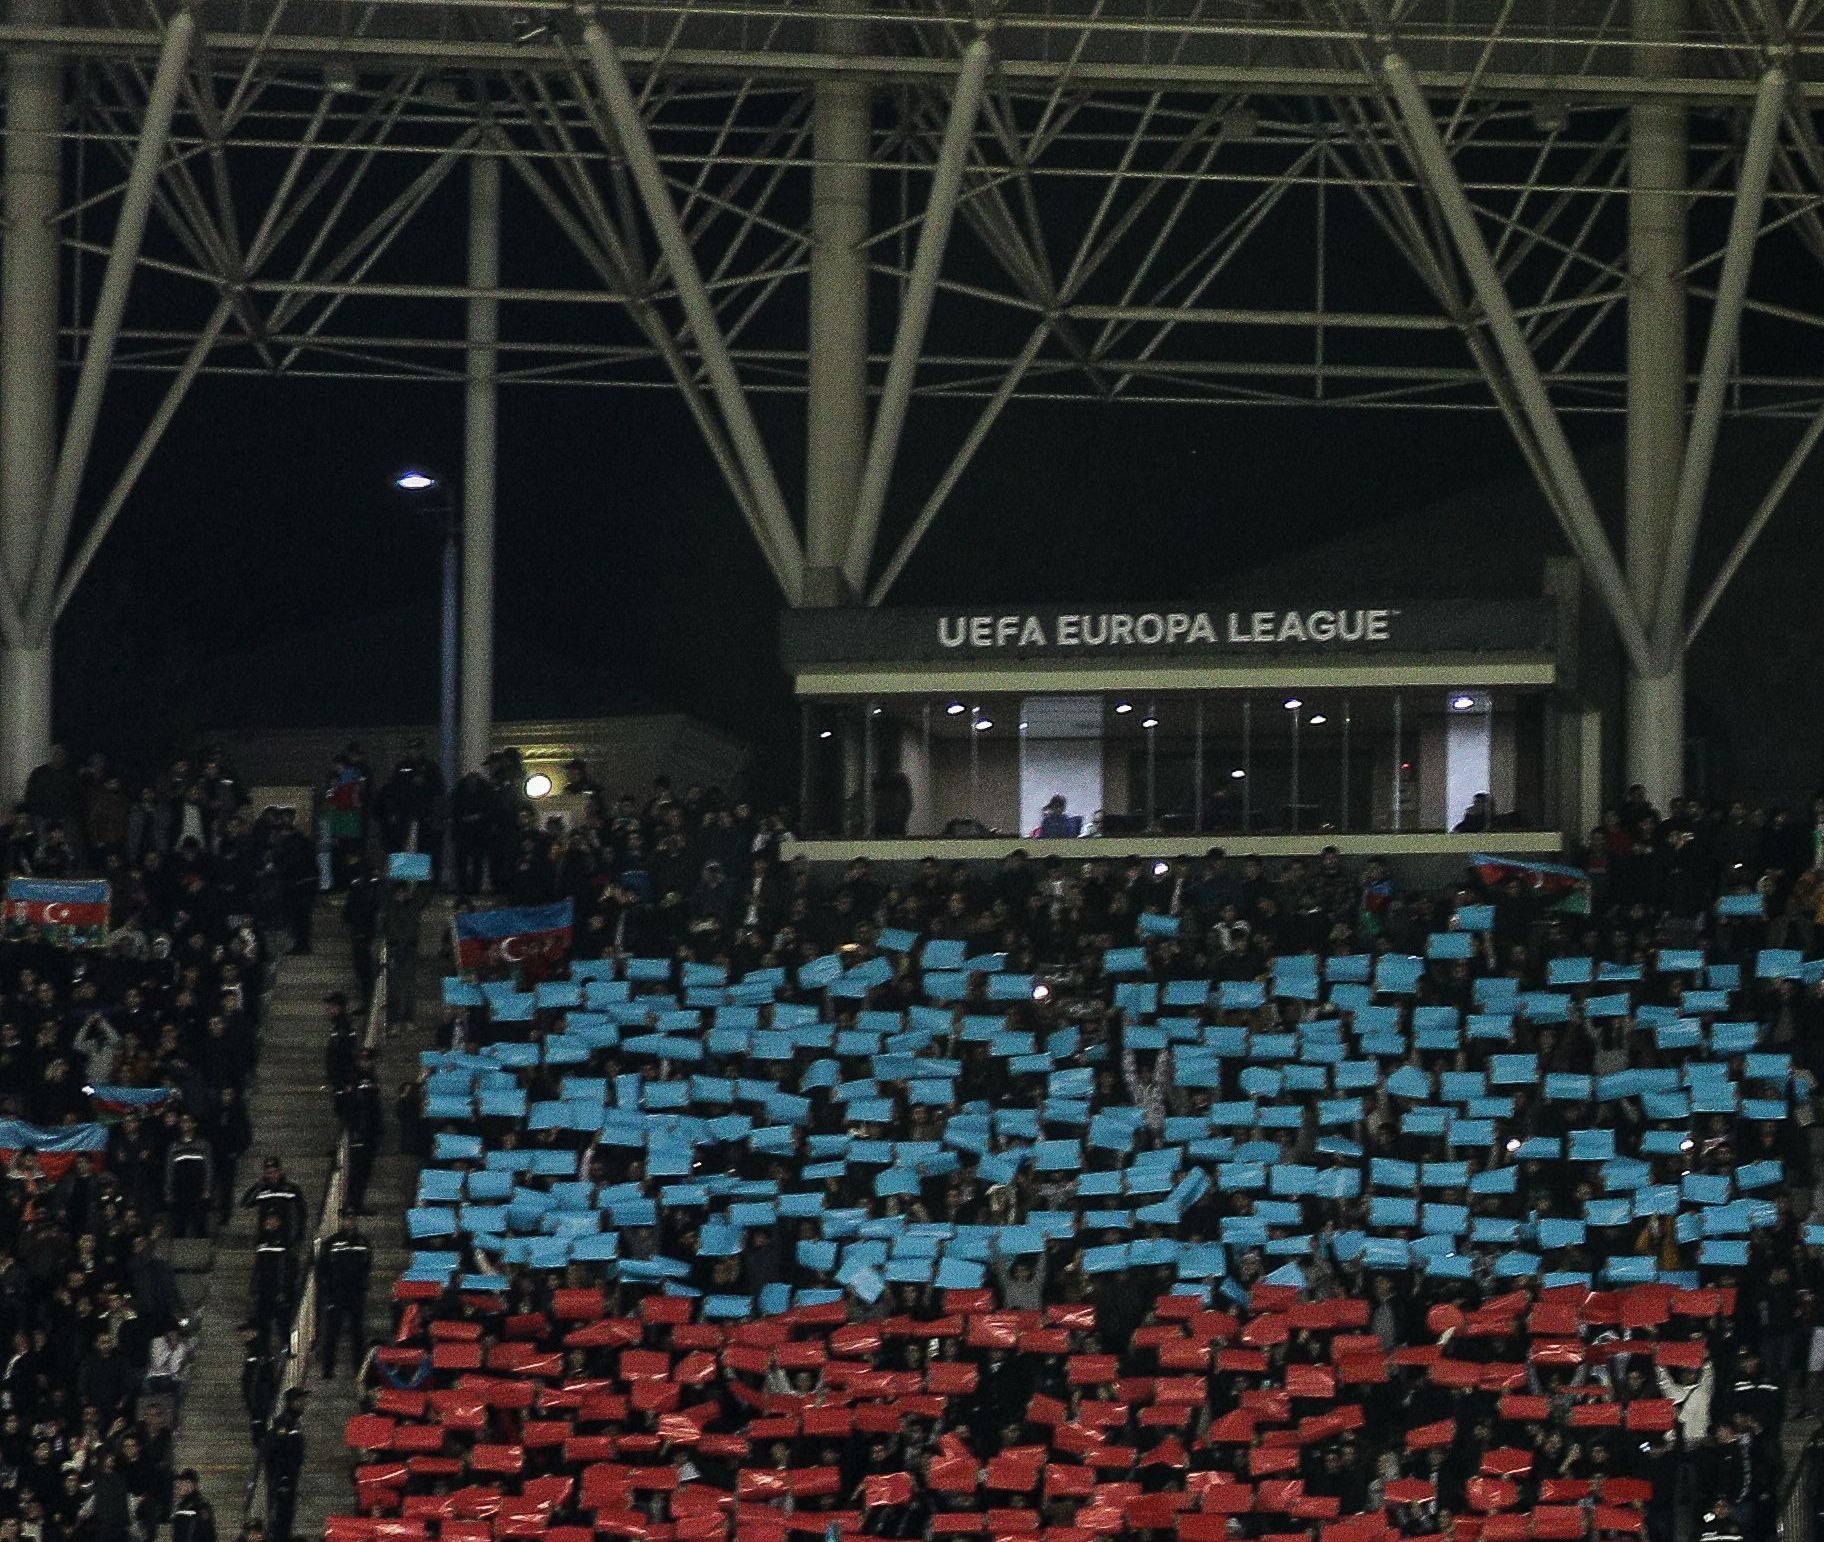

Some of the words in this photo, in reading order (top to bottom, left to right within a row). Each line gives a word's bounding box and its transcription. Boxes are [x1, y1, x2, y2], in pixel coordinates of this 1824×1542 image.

[937, 615, 1047, 648] UEFA
[1056, 612, 1217, 646] EUROPA
[1227, 609, 1391, 643] LEAGUE
